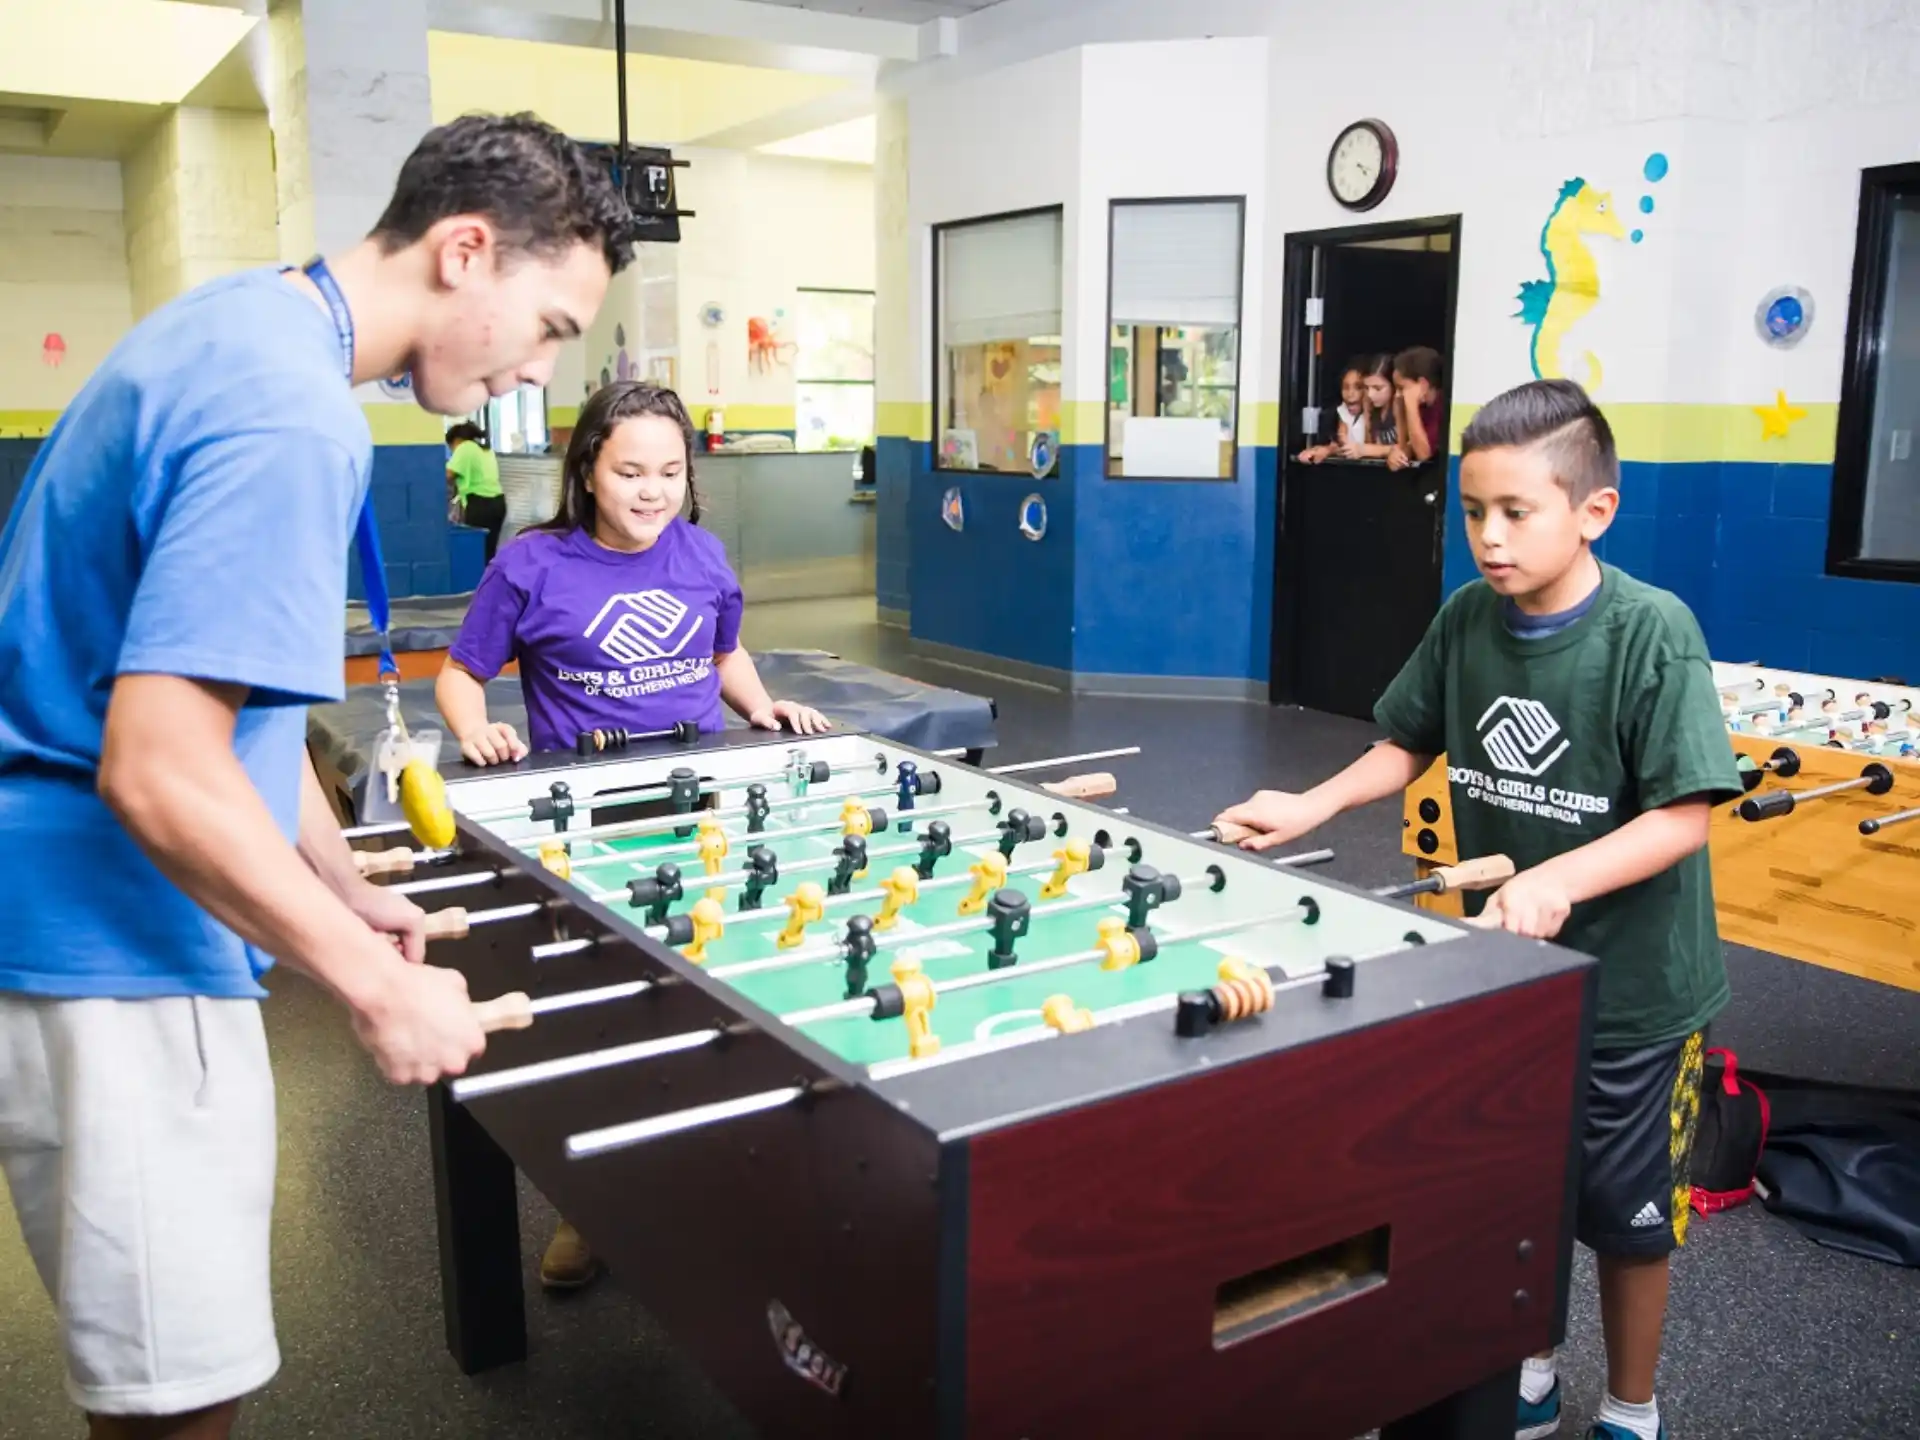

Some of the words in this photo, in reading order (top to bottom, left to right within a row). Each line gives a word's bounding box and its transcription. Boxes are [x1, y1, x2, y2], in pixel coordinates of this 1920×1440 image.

[607, 670, 626, 686] &
[630, 660, 684, 682] GIRLS
[1447, 766, 1484, 787] BOYS
[1483, 774, 1496, 791] &
[1496, 778, 1546, 801] GIRLS
[1549, 787, 1610, 814] CLUBS
[1467, 786, 1482, 799] OF
[1482, 790, 1534, 814] SOUTHERN
[1535, 803, 1581, 825] NEVADA
